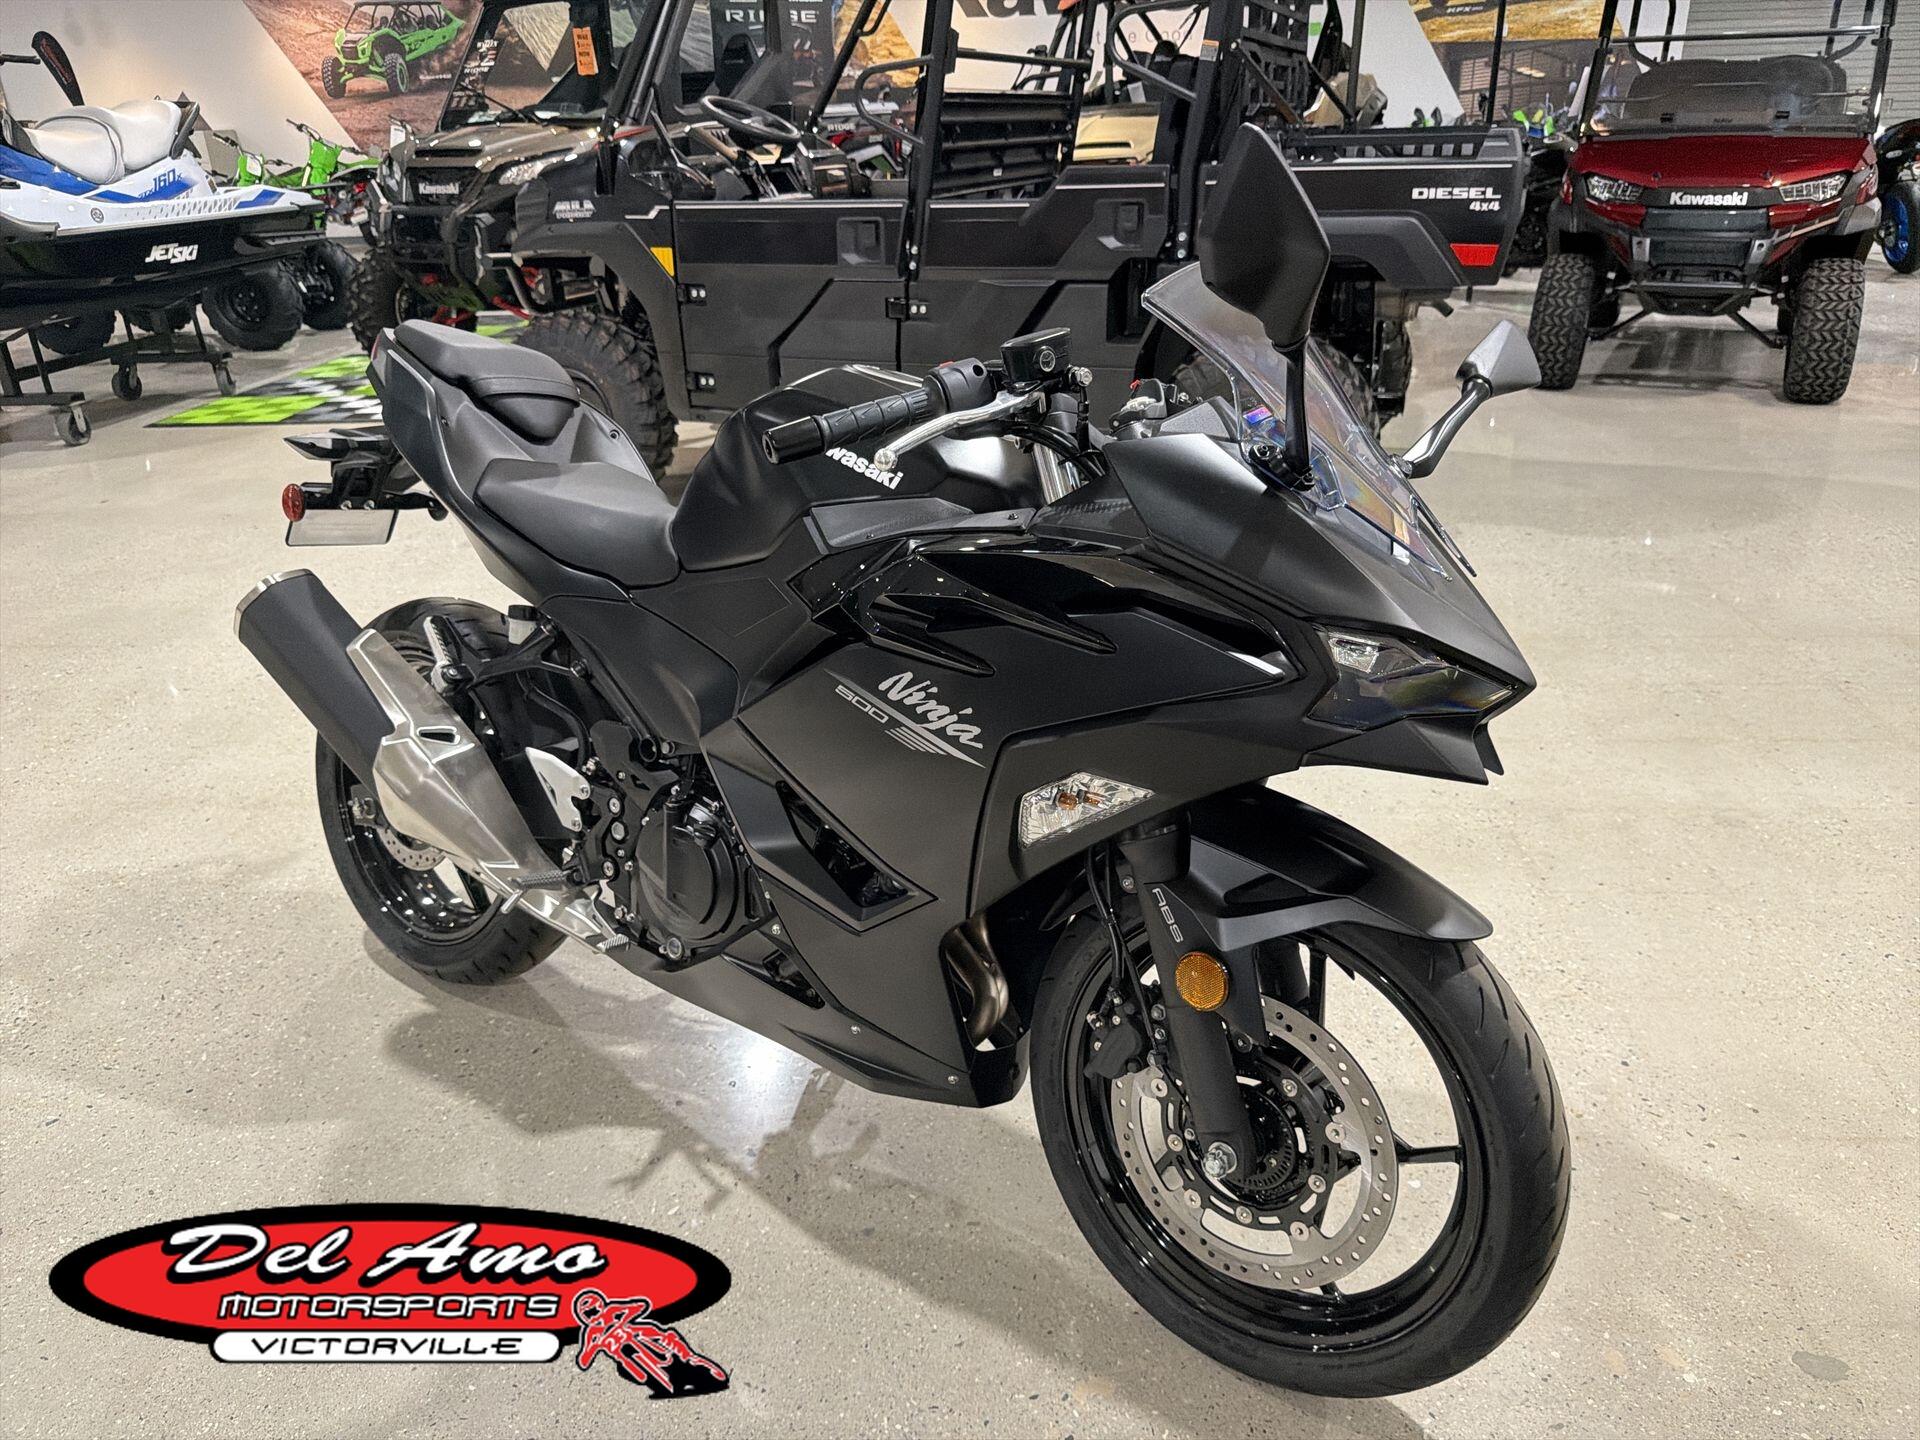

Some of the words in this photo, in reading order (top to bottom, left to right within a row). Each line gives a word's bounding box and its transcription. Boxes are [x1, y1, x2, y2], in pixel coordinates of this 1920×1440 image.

[418, 182, 460, 194] Kawasaki
[1411, 187, 1502, 200] DIESEL
[1669, 191, 1749, 206] Kawasaki
[825, 447, 904, 490] wasaki
[835, 684, 889, 723] 500
[878, 671, 984, 749] Ninja
[1152, 887, 1184, 943] ABS
